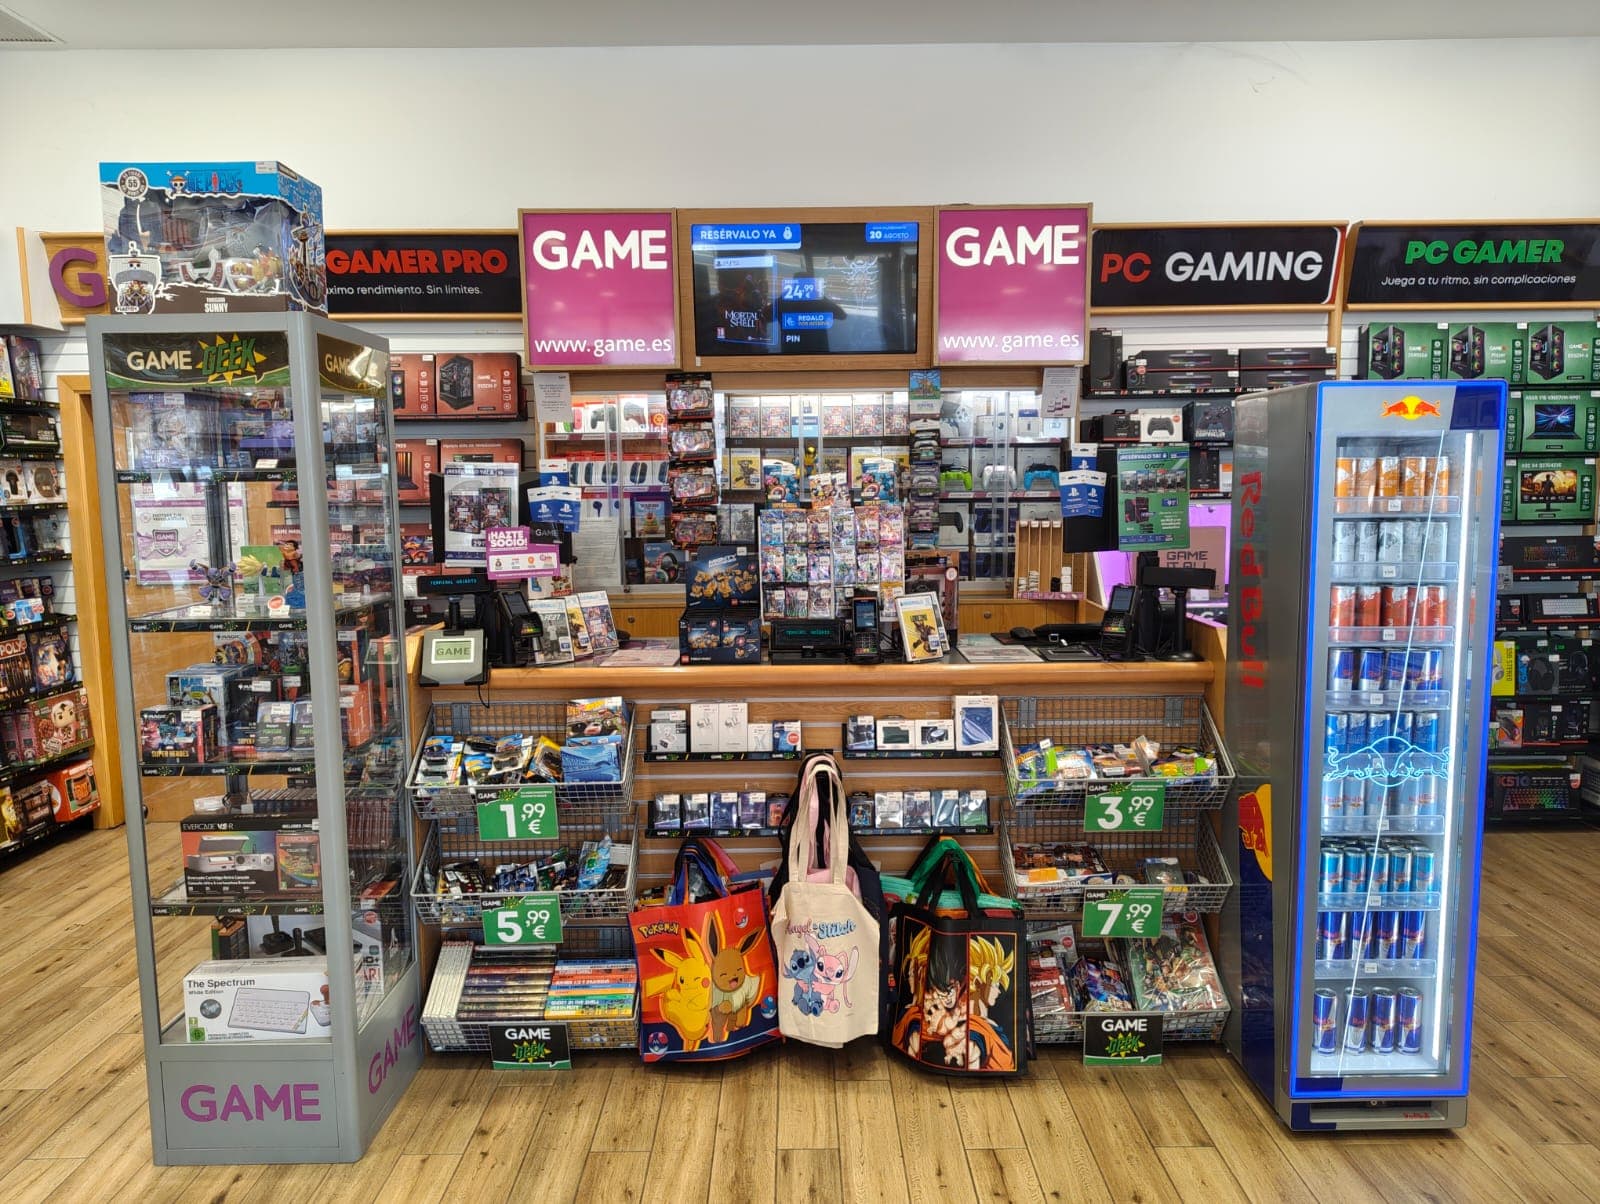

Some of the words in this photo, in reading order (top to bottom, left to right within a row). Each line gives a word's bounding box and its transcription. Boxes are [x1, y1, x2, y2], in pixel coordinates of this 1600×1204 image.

[127, 178, 139, 189] 55
[700, 228, 761, 240] RESÉRVALO
[763, 229, 777, 240] YA
[884, 231, 910, 240] AGOSTO
[533, 229, 668, 271] GAME
[946, 224, 1080, 267] GAME
[1405, 240, 1450, 265] PC
[1452, 239, 1565, 265] GAMER
[325, 248, 440, 275] GAMER
[442, 248, 508, 275] PRO
[1100, 252, 1152, 284] PC
[1165, 250, 1323, 283] GAMING
[1381, 275, 1416, 288] Juega
[1418, 276, 1426, 286] a
[1428, 275, 1439, 286] tu
[1441, 274, 1471, 286] ritmo,
[1473, 273, 1490, 285] sin
[1491, 273, 1577, 286] complicaciones
[357, 283, 424, 296] rendimiento.
[427, 284, 443, 295] Sin
[204, 302, 229, 313] SUNNY
[786, 335, 801, 343] PIN
[943, 332, 1080, 354] www.game.es
[534, 336, 673, 358] www.game.es
[126, 349, 193, 372] GAME
[202, 338, 257, 376] GEEK
[1240, 470, 1263, 577] Red
[488, 530, 524, 541] ¡HAZTE
[535, 528, 559, 537] GAME
[490, 538, 528, 547] SOCIO!
[1166, 551, 1208, 561] GAME
[1240, 585, 1264, 688] Bull
[436, 647, 471, 656] GAME
[477, 792, 498, 800] GAME
[1133, 811, 1147, 827] €
[182, 822, 216, 831] EVERCADE
[528, 819, 542, 835] €
[533, 925, 546, 939] €
[1131, 919, 1145, 933] €
[187, 980, 205, 989] The
[208, 978, 256, 989] Spectrum
[1101, 1018, 1148, 1032] GAME
[504, 1027, 551, 1040] GAME
[367, 1003, 417, 1095] GAME
[180, 1083, 322, 1123] GAME
